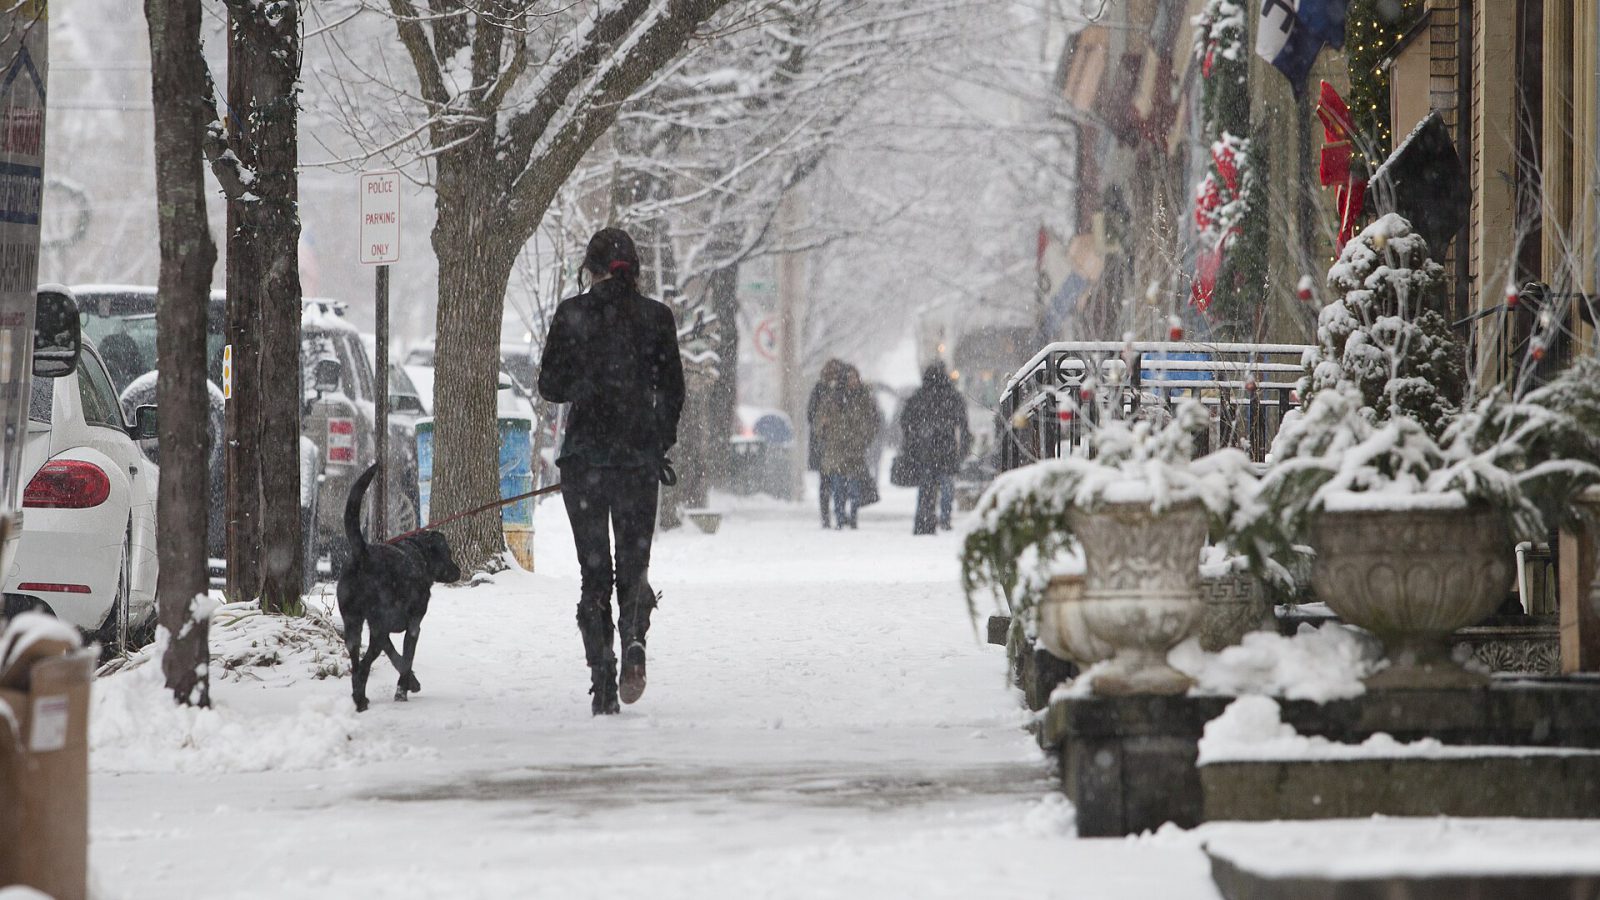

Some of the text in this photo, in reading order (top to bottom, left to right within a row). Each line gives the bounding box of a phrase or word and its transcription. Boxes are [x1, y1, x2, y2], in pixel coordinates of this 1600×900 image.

[368, 181, 393, 194] POLICE
[365, 212, 395, 225] PARKING
[371, 243, 389, 256] ONLY
